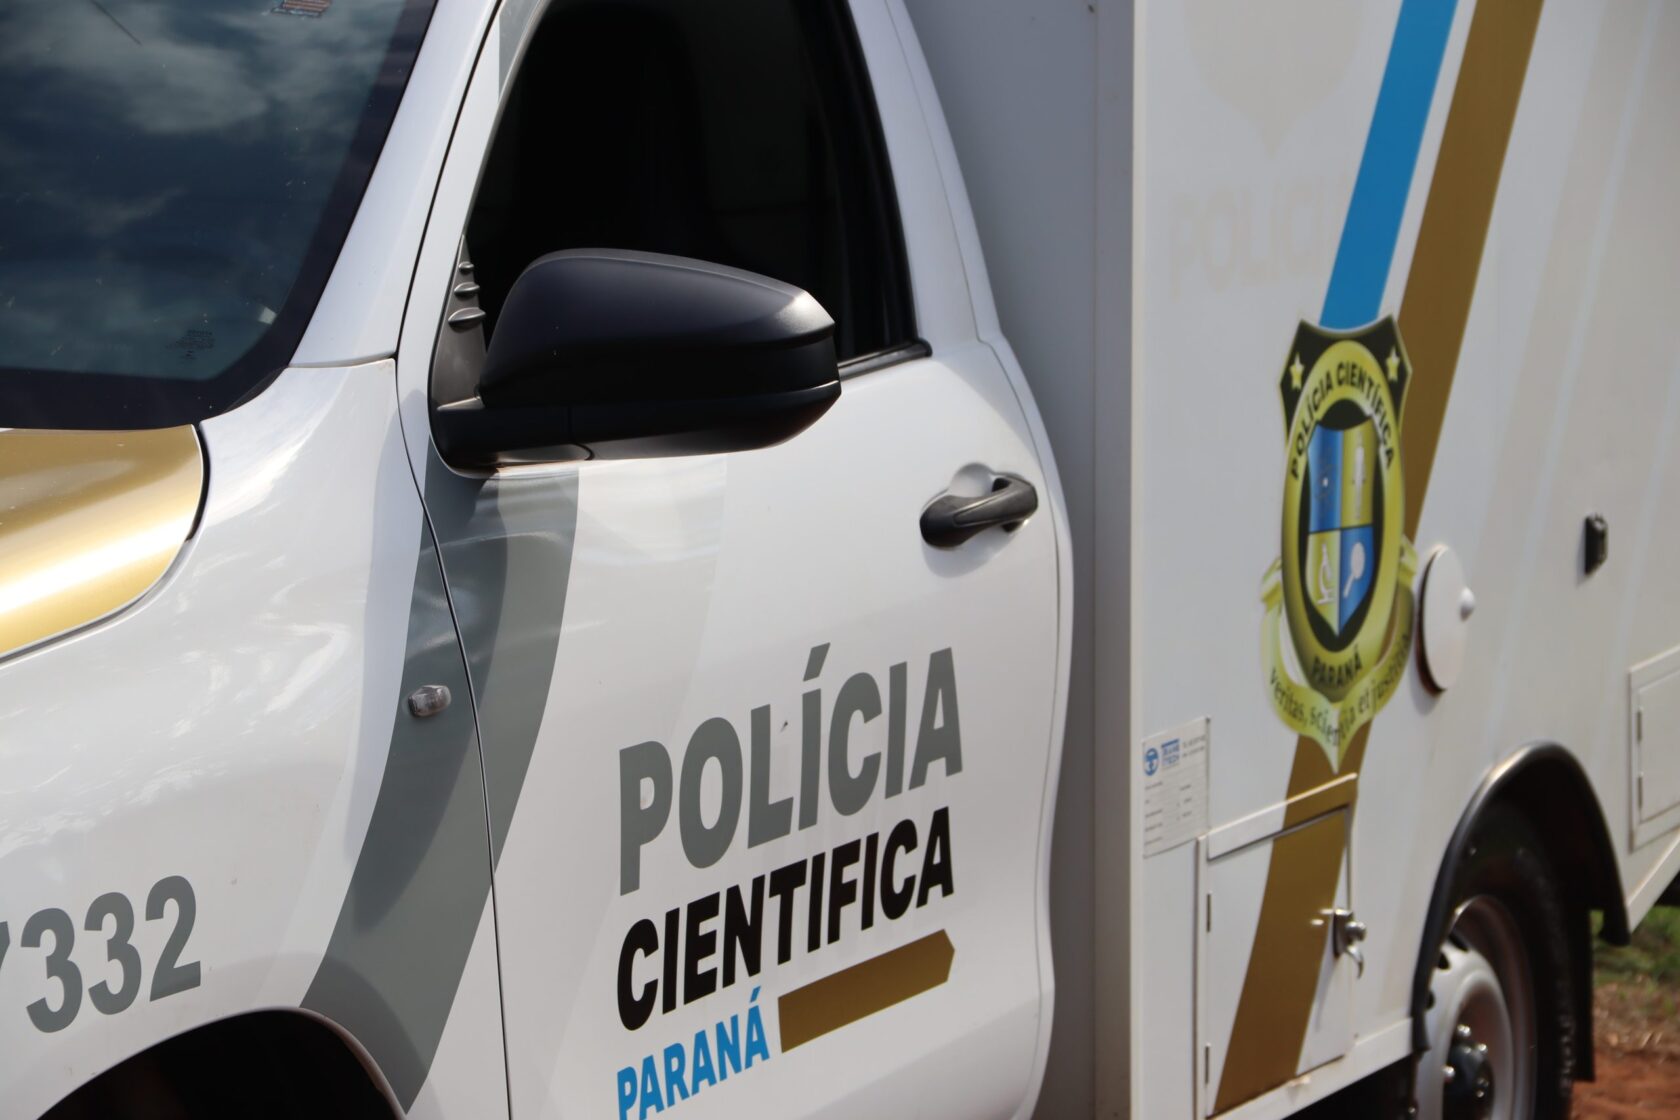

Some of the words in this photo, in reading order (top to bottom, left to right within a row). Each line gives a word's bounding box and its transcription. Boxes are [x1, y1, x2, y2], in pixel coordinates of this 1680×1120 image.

[1291, 369, 1333, 481] POLÍCIA
[1312, 644, 1363, 688] PARANÁ
[619, 642, 963, 896] POLÍCIA
[0, 875, 201, 1033] 332
[617, 806, 954, 1031] CIENTIFICA
[617, 985, 770, 1120] PARANÁ
